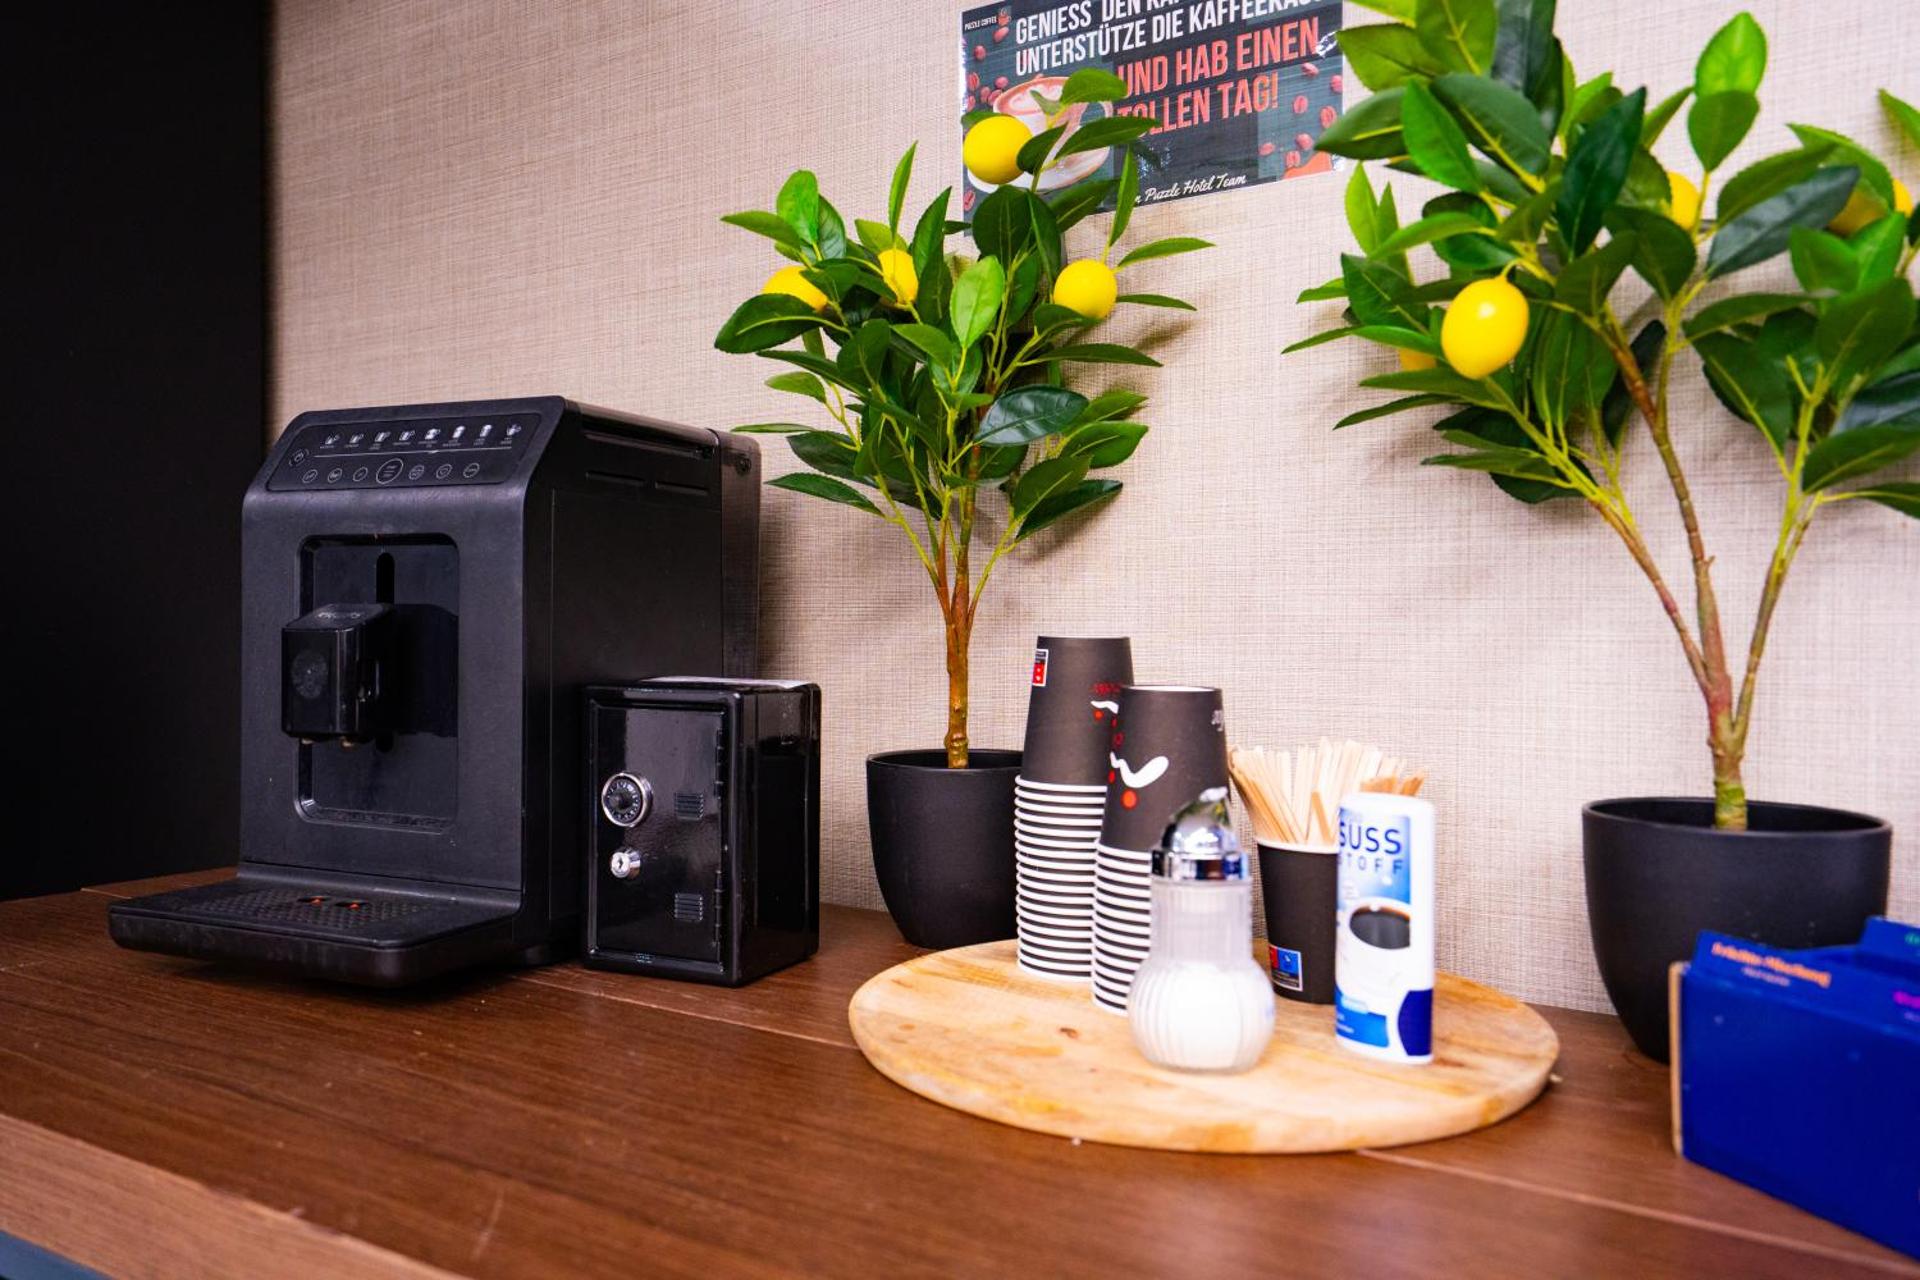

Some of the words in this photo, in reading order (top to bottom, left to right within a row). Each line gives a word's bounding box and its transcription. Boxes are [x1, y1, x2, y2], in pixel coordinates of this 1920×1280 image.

[1016, 0, 1092, 45] GENIESS
[1102, 0, 1141, 22] DEN
[1016, 19, 1146, 76] UNTERSTÜTZE
[1152, 9, 1183, 43] DIE
[1188, 0, 1324, 33] KAFFEEK
[1117, 55, 1168, 98] UND
[1176, 40, 1228, 86] HAB
[1236, 17, 1319, 71] EINEN
[1217, 71, 1279, 119] TAG!
[1145, 182, 1181, 202] Puzzle
[1183, 175, 1215, 195] Hotel
[1216, 173, 1247, 189] Team
[1339, 852, 1403, 875] TOFF
